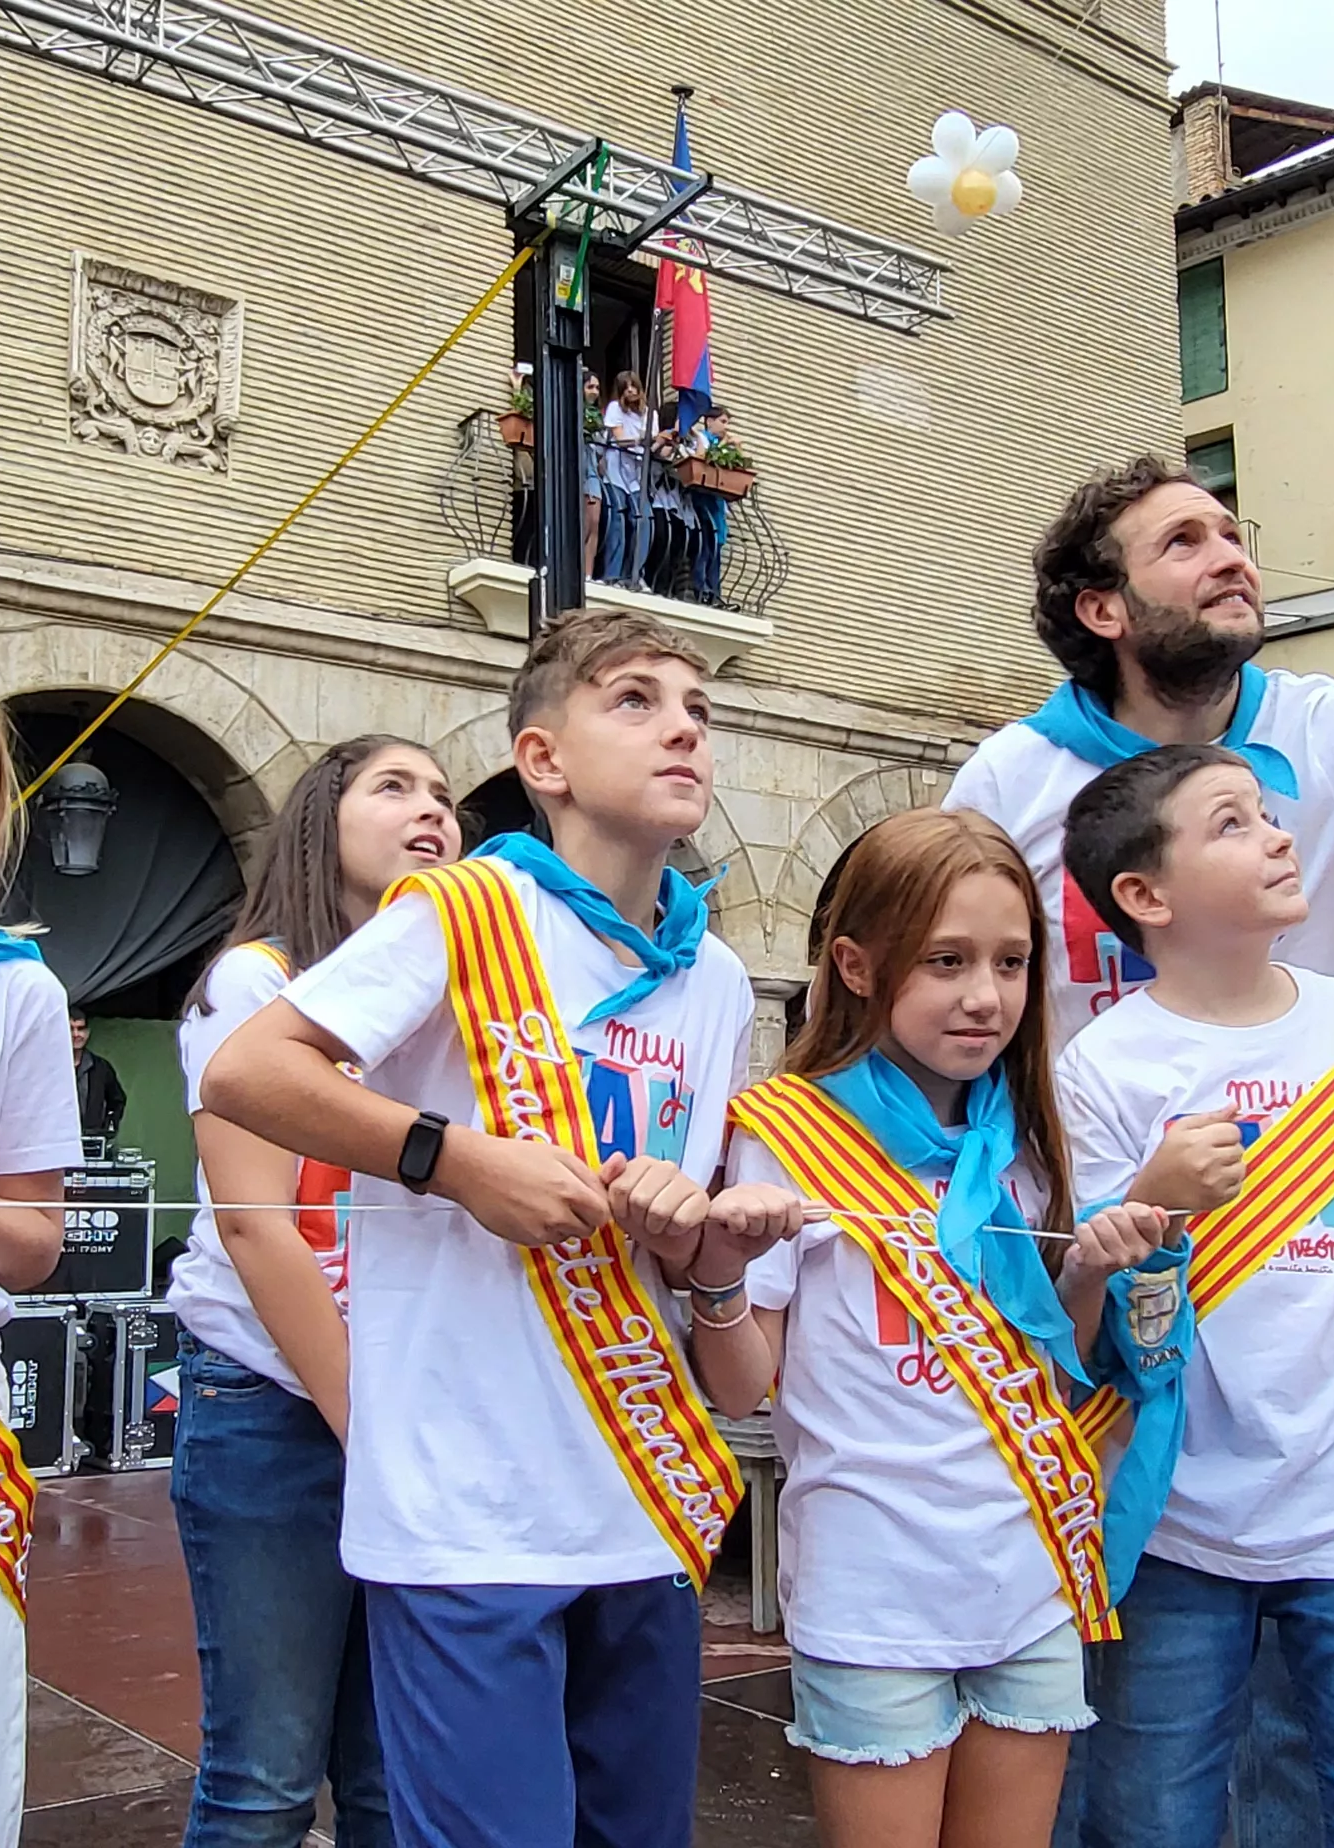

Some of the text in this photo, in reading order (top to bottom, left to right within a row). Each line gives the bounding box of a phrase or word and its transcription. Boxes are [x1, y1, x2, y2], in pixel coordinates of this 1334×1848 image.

[1090, 955, 1142, 1016] d
[605, 1018, 687, 1129] muy
[594, 1314, 728, 1552] Monzón
